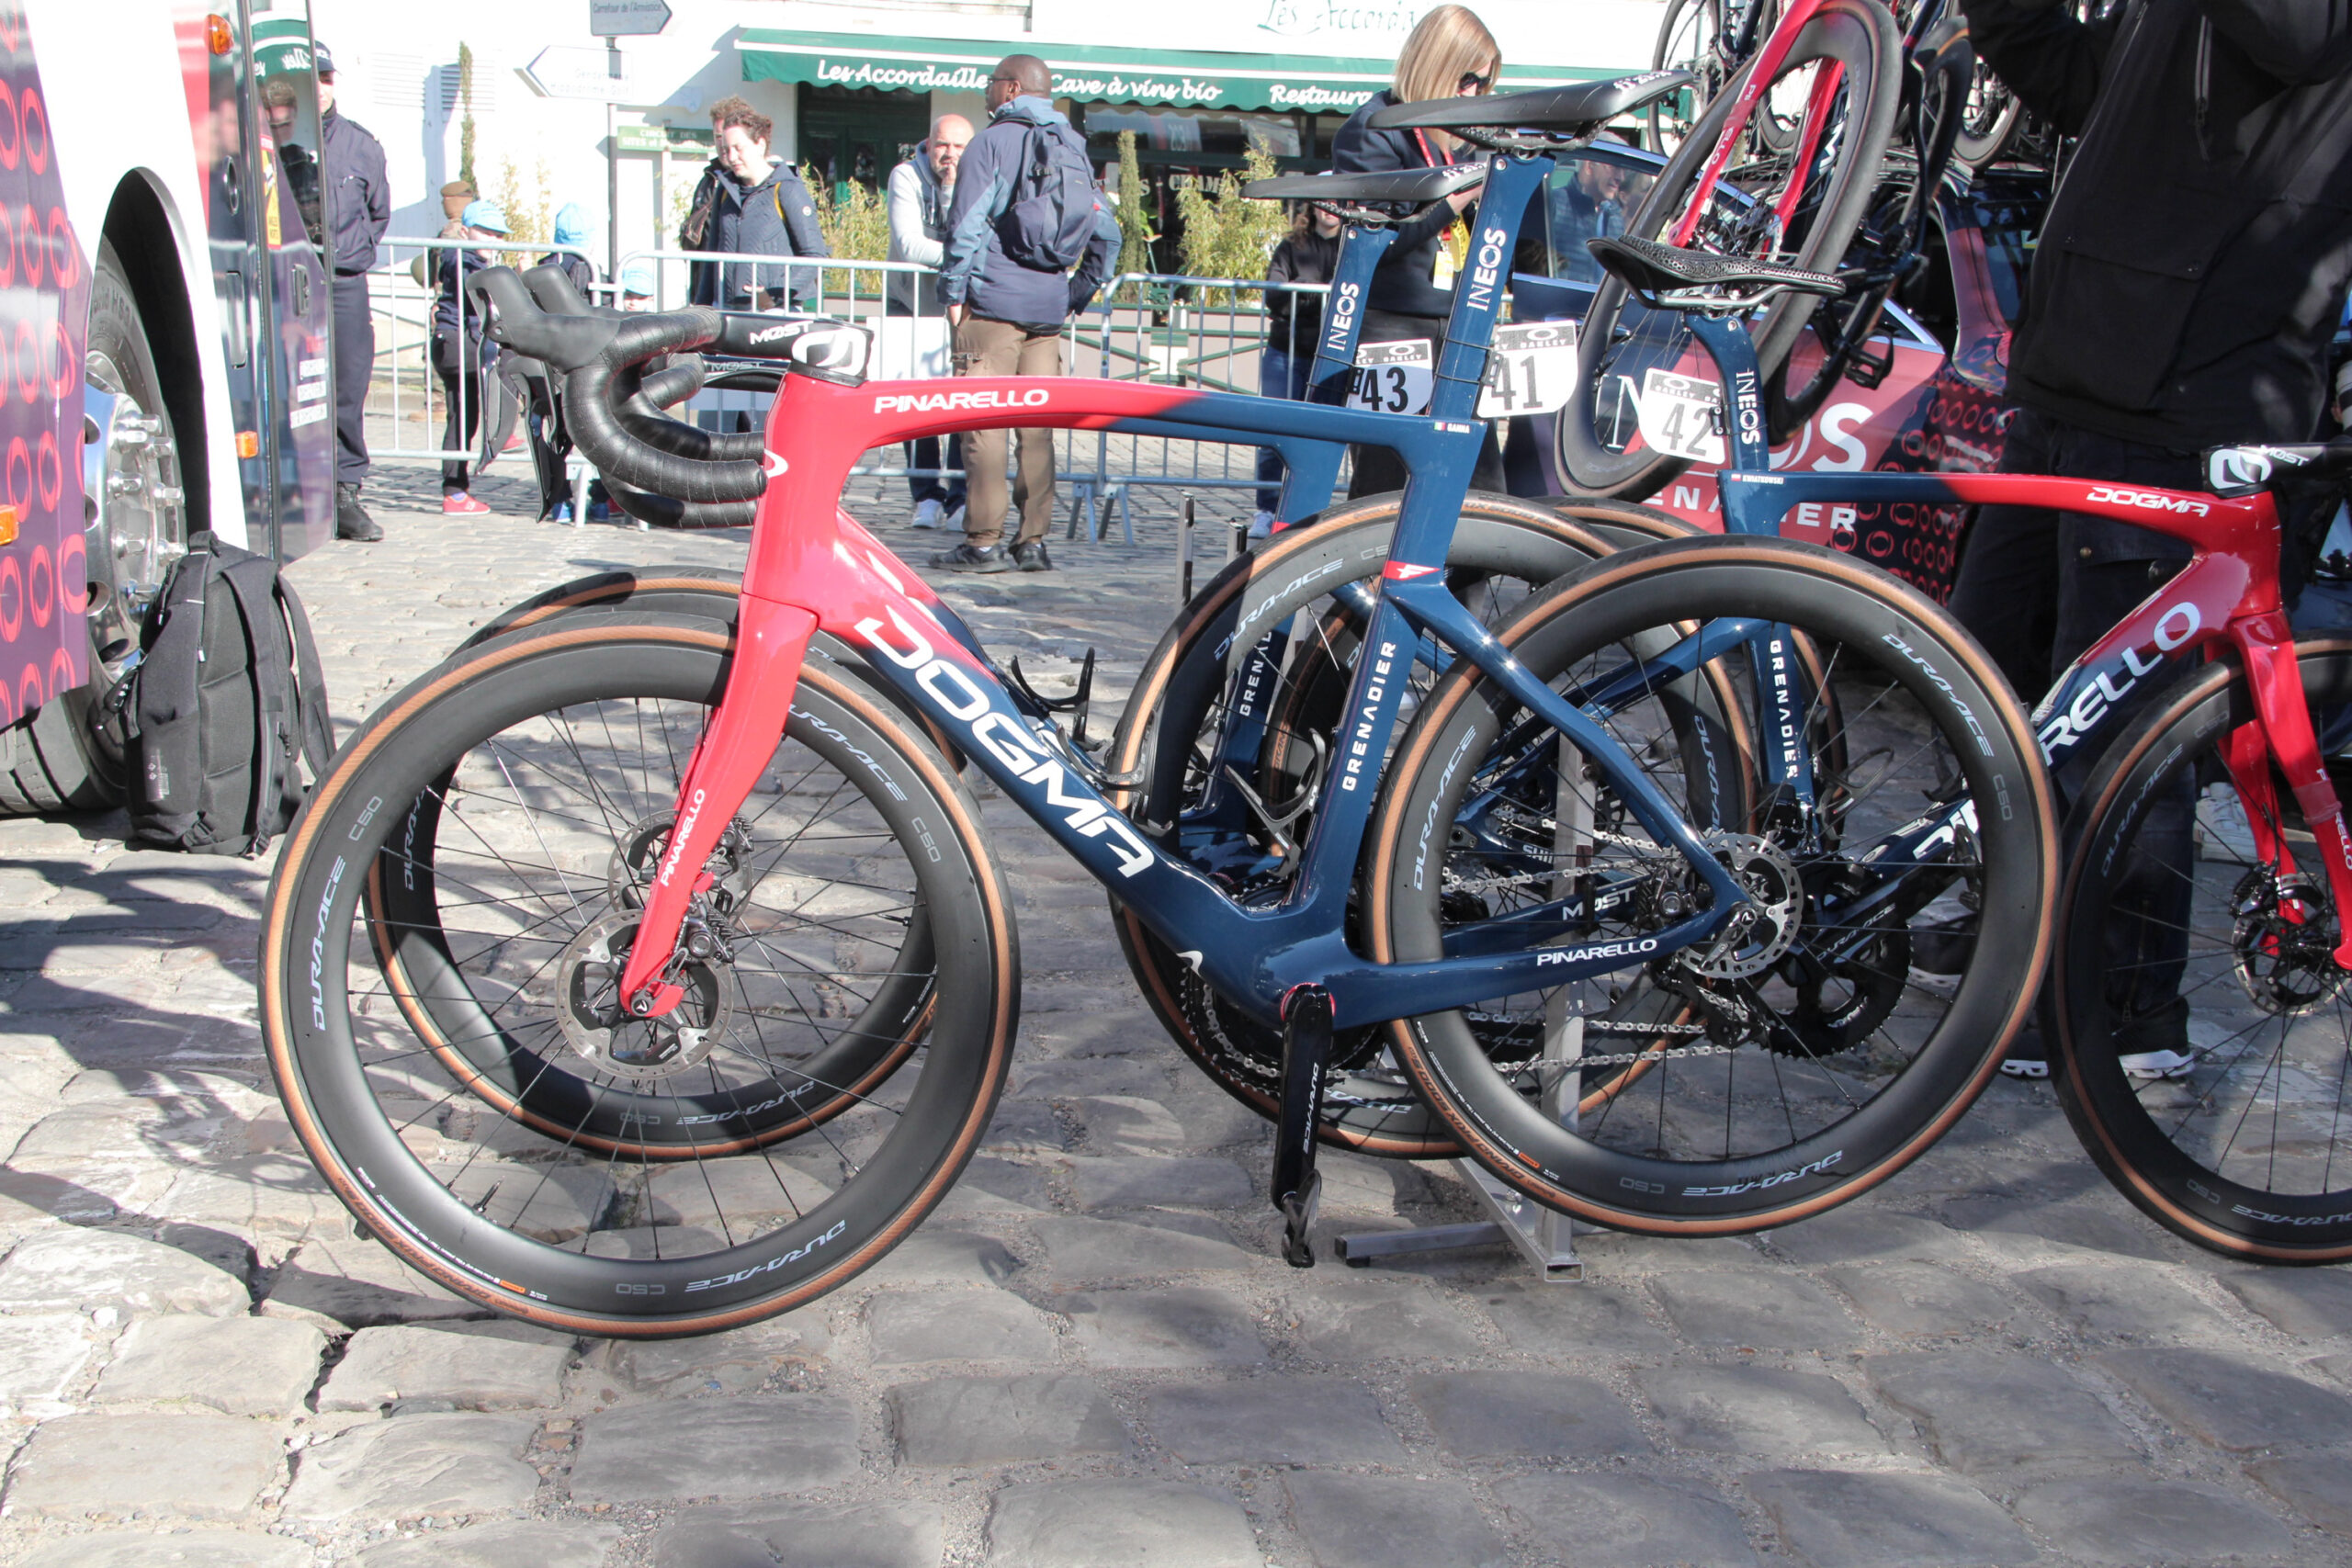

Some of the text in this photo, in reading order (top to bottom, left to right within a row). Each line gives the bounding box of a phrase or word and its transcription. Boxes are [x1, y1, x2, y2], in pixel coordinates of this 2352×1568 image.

[817, 59, 1374, 107] Les Accordaille Cave à vins bio Restaura
[1466, 228, 1507, 312] INEOS
[1327, 281, 1360, 352] INEOS
[874, 389, 1049, 414] PINARELLO
[1361, 367, 1408, 413] 43
[1490, 355, 1544, 411] 41
[1736, 369, 1761, 446] INEOS
[1661, 402, 1713, 457] 42
[2086, 486, 2210, 518] DOGMA
[1360, 544, 1389, 561] C5
[1214, 558, 1344, 662] DURA-ACE
[1341, 641, 1396, 792] GRENADIER
[1770, 639, 1799, 779] GRENADIER
[1881, 633, 1995, 758] DURA-ACE
[2036, 601, 2201, 767] RELLO
[788, 704, 909, 802] URA-ACE
[854, 604, 1155, 879] DOGMA
[1694, 715, 1721, 831] DURA-A
[348, 795, 383, 842] C50
[1413, 724, 1476, 891] DURA-ACE
[1992, 773, 2014, 821] C50
[403, 788, 426, 891] DURA-
[660, 788, 706, 887] PINARELLO
[910, 816, 942, 863] C50
[311, 854, 346, 1032] DURA-ACE
[1536, 938, 1657, 967] PINARELLO
[675, 1080, 815, 1125] DURA-ACE
[1619, 1150, 1843, 1196] C50 DURA-ACE
[616, 1219, 846, 1296] C50 DURA-ACE
